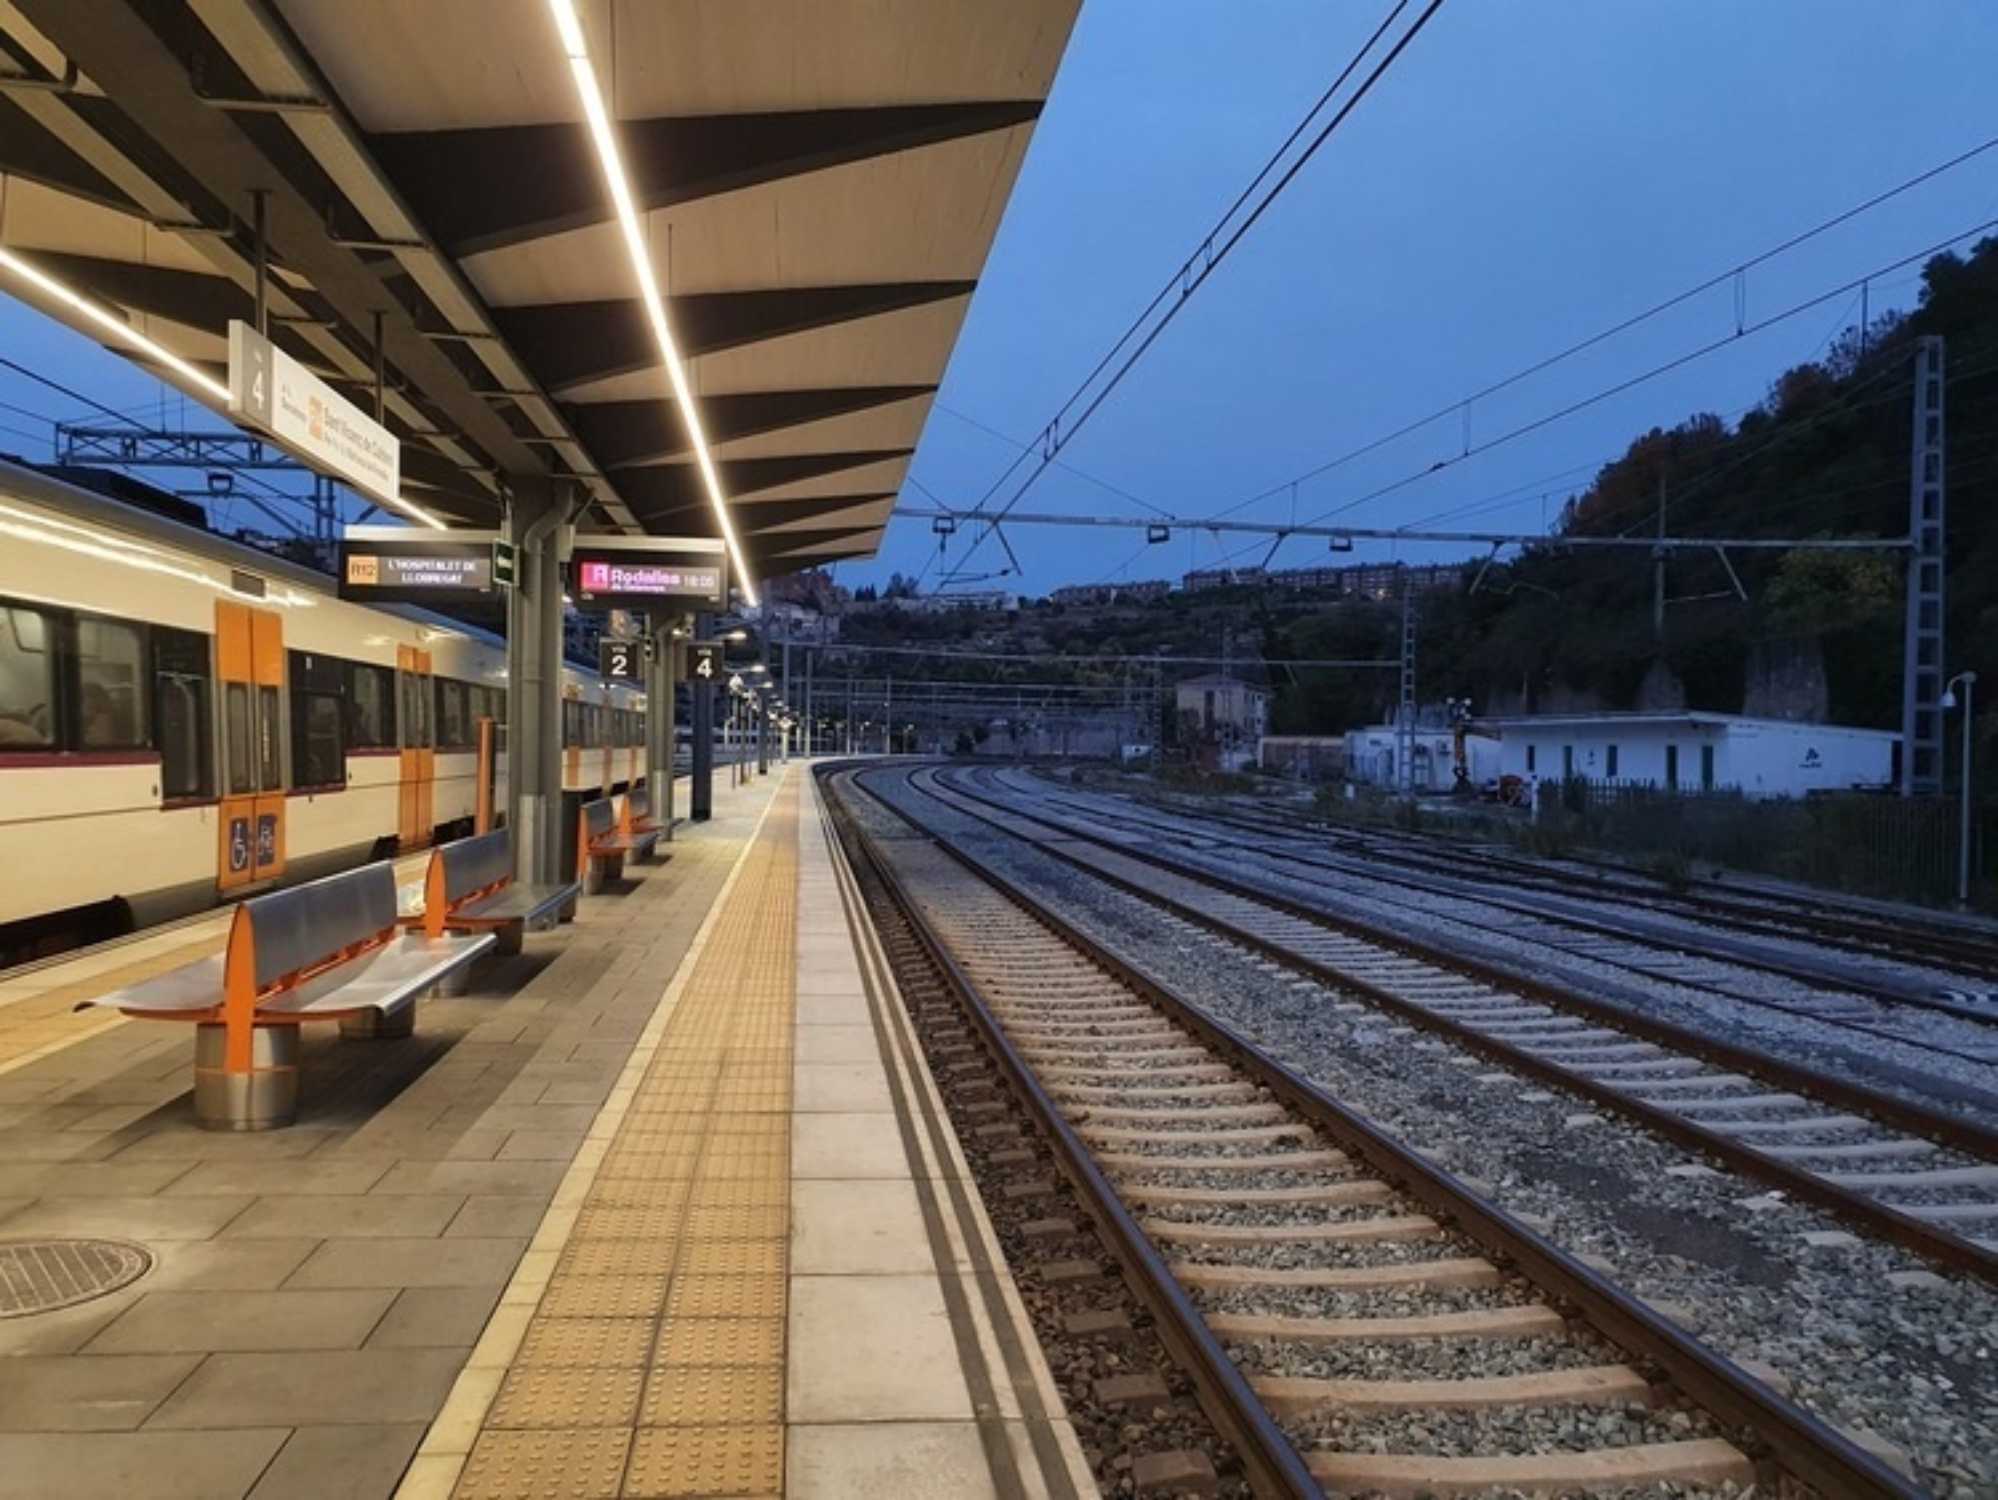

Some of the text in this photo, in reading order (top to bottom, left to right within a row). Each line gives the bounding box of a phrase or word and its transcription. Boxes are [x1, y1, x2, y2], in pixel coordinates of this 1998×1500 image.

[252, 370, 264, 410] 4
[611, 655, 627, 675] 2
[697, 658, 712, 678] 4
